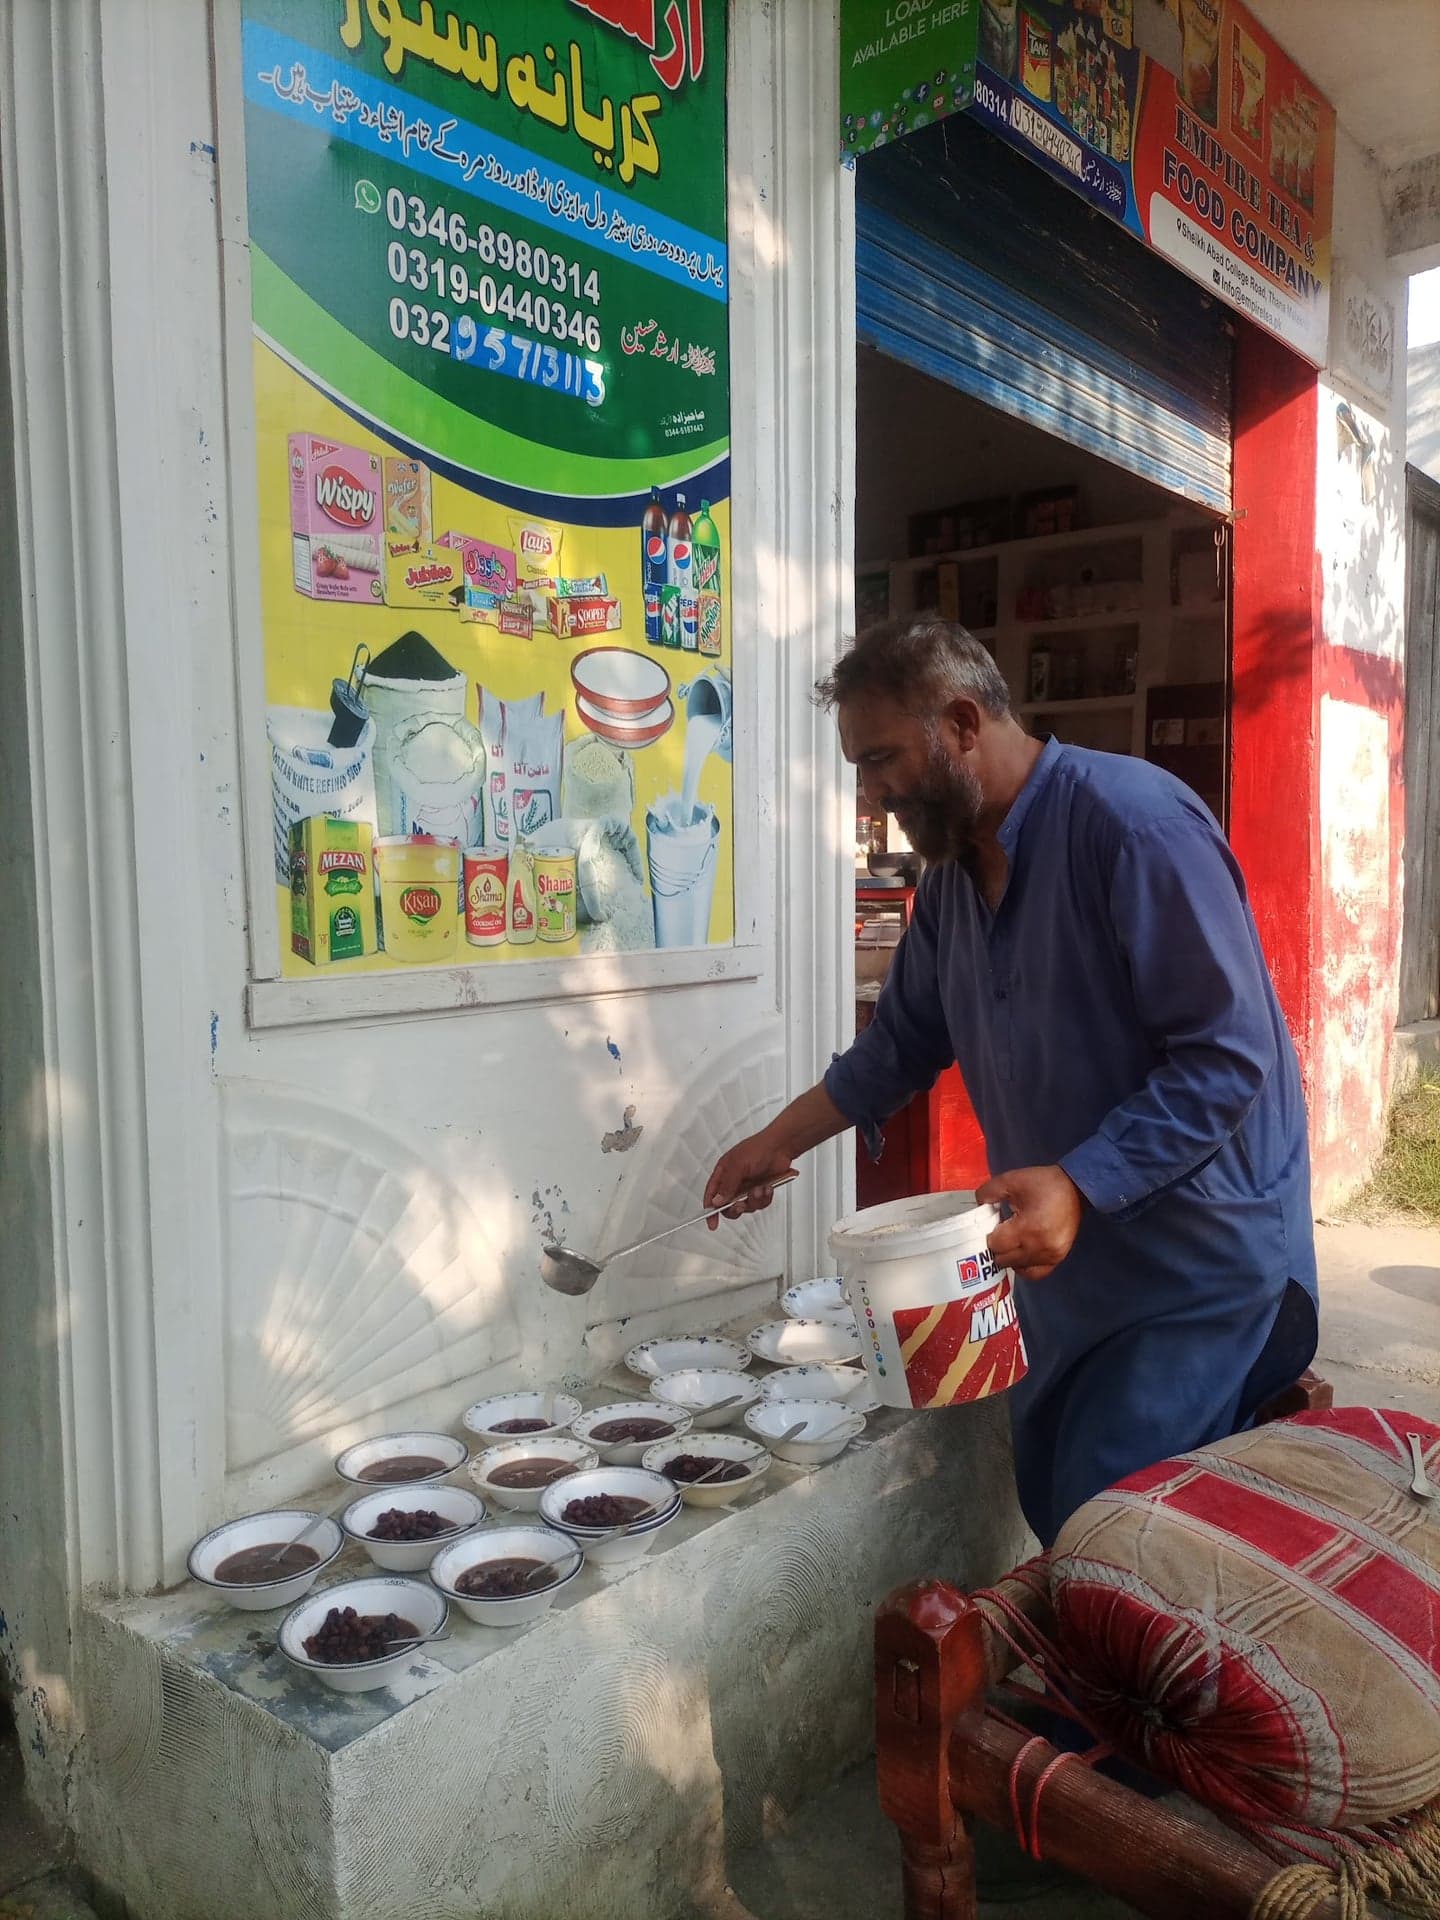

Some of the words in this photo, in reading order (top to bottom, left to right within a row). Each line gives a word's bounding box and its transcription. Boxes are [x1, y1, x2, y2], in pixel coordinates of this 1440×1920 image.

[852, 18, 927, 68] AVAILABLE
[931, 2, 970, 30] HERE
[506, 42, 661, 184] کریانہ
[973, 79, 1008, 122] 80314
[402, 118, 432, 158] تمام
[430, 118, 461, 162] کے
[1175, 104, 1260, 213] EMPIRE
[1267, 190, 1302, 253] TEA
[1304, 231, 1319, 267] &
[387, 187, 601, 305] 0346-8980314
[1163, 147, 1226, 231] FOOD
[1231, 208, 1322, 305] COMPANY
[684, 251, 698, 280] پر
[696, 253, 725, 288] یہاں
[1181, 222, 1206, 254] Sheikh
[1206, 242, 1224, 267] Abad
[1225, 257, 1249, 287] College
[387, 241, 601, 352] 0319-0440346
[315, 469, 375, 521] Wispy
[404, 563, 453, 589] Jubilee
[576, 607, 606, 630] SOOPER
[321, 853, 364, 871] MEZAN
[403, 891, 439, 910] Kisan
[470, 884, 503, 905] Shama
[538, 874, 573, 898] Shama
